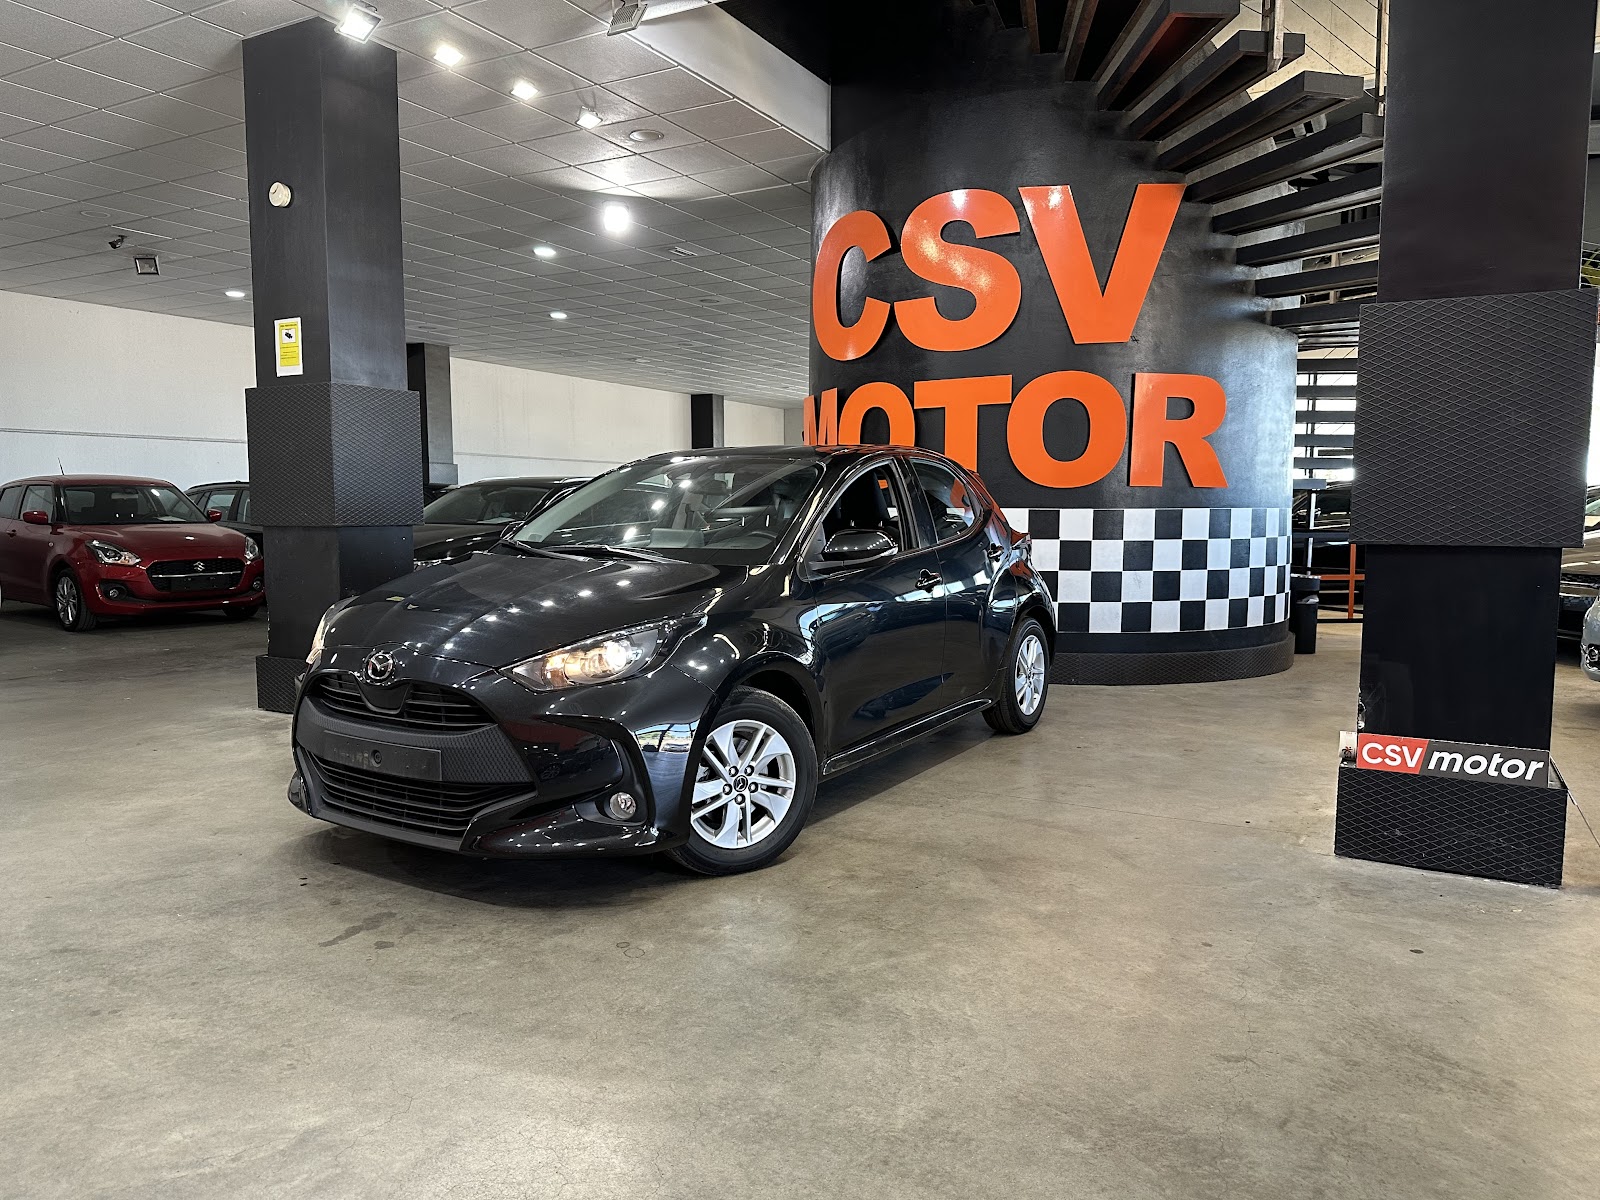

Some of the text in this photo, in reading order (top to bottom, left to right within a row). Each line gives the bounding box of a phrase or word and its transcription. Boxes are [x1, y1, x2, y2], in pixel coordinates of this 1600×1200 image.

[813, 184, 1186, 361] CSV
[803, 370, 1228, 489] MOTOR
[1361, 742, 1423, 768] CSV
[1427, 750, 1545, 781] motor
